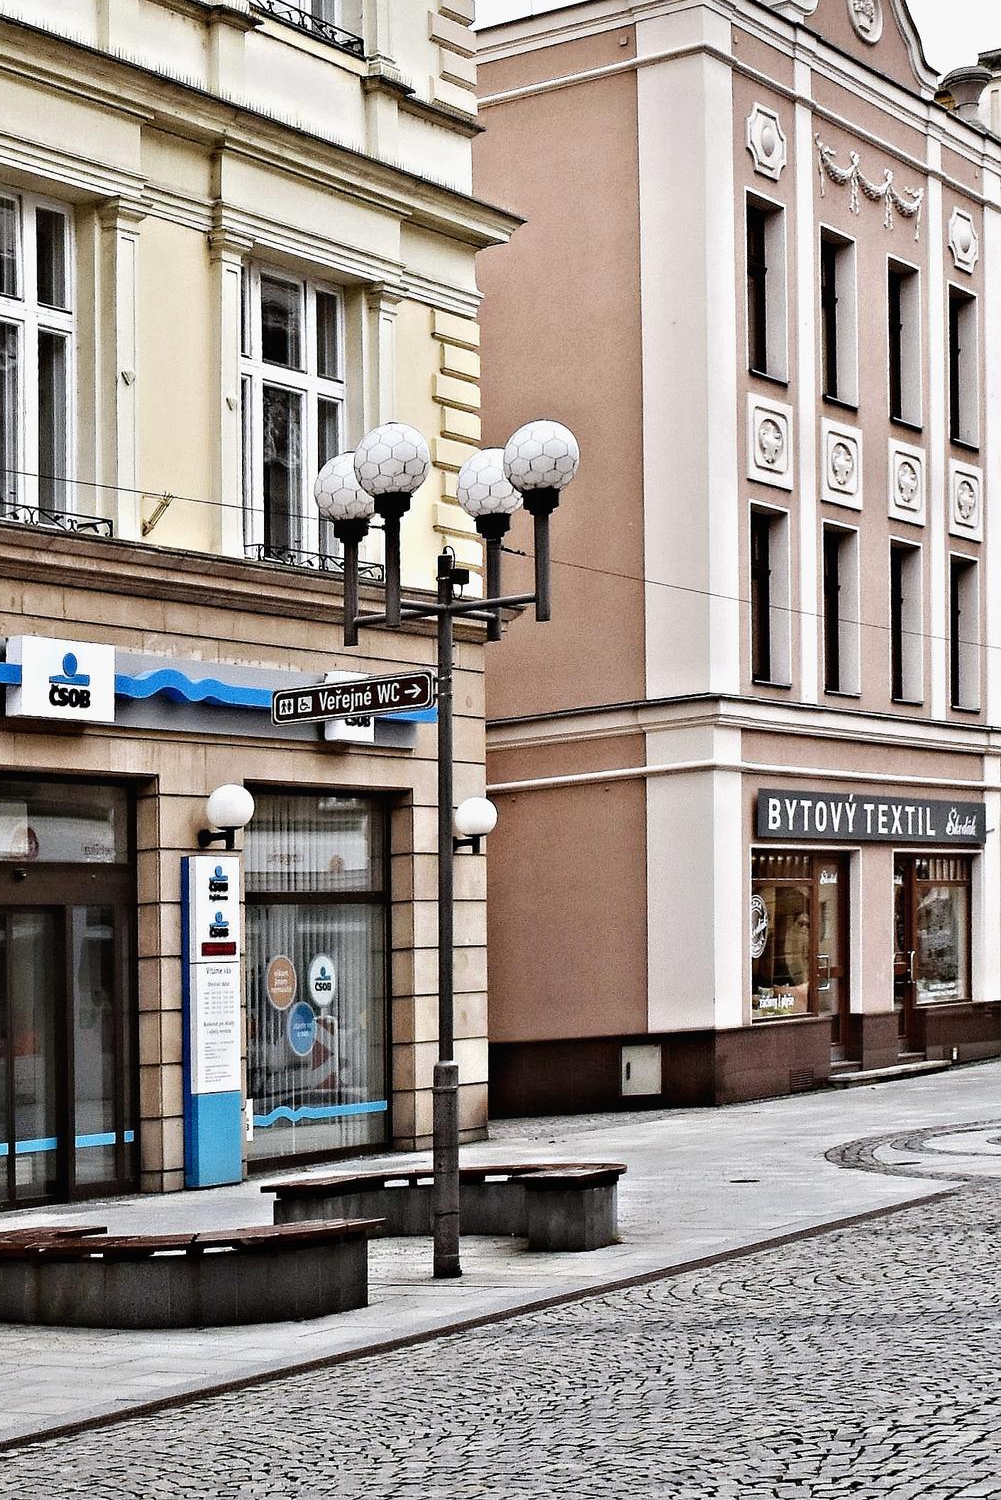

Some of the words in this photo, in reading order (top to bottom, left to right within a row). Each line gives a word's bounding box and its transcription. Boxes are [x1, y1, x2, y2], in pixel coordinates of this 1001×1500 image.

[49, 684, 91, 709] ČSOB
[319, 687, 372, 712] Veřejné
[377, 682, 400, 704] WC
[768, 794, 857, 833] BYTOVÝ
[864, 803, 936, 836] TEXTIL
